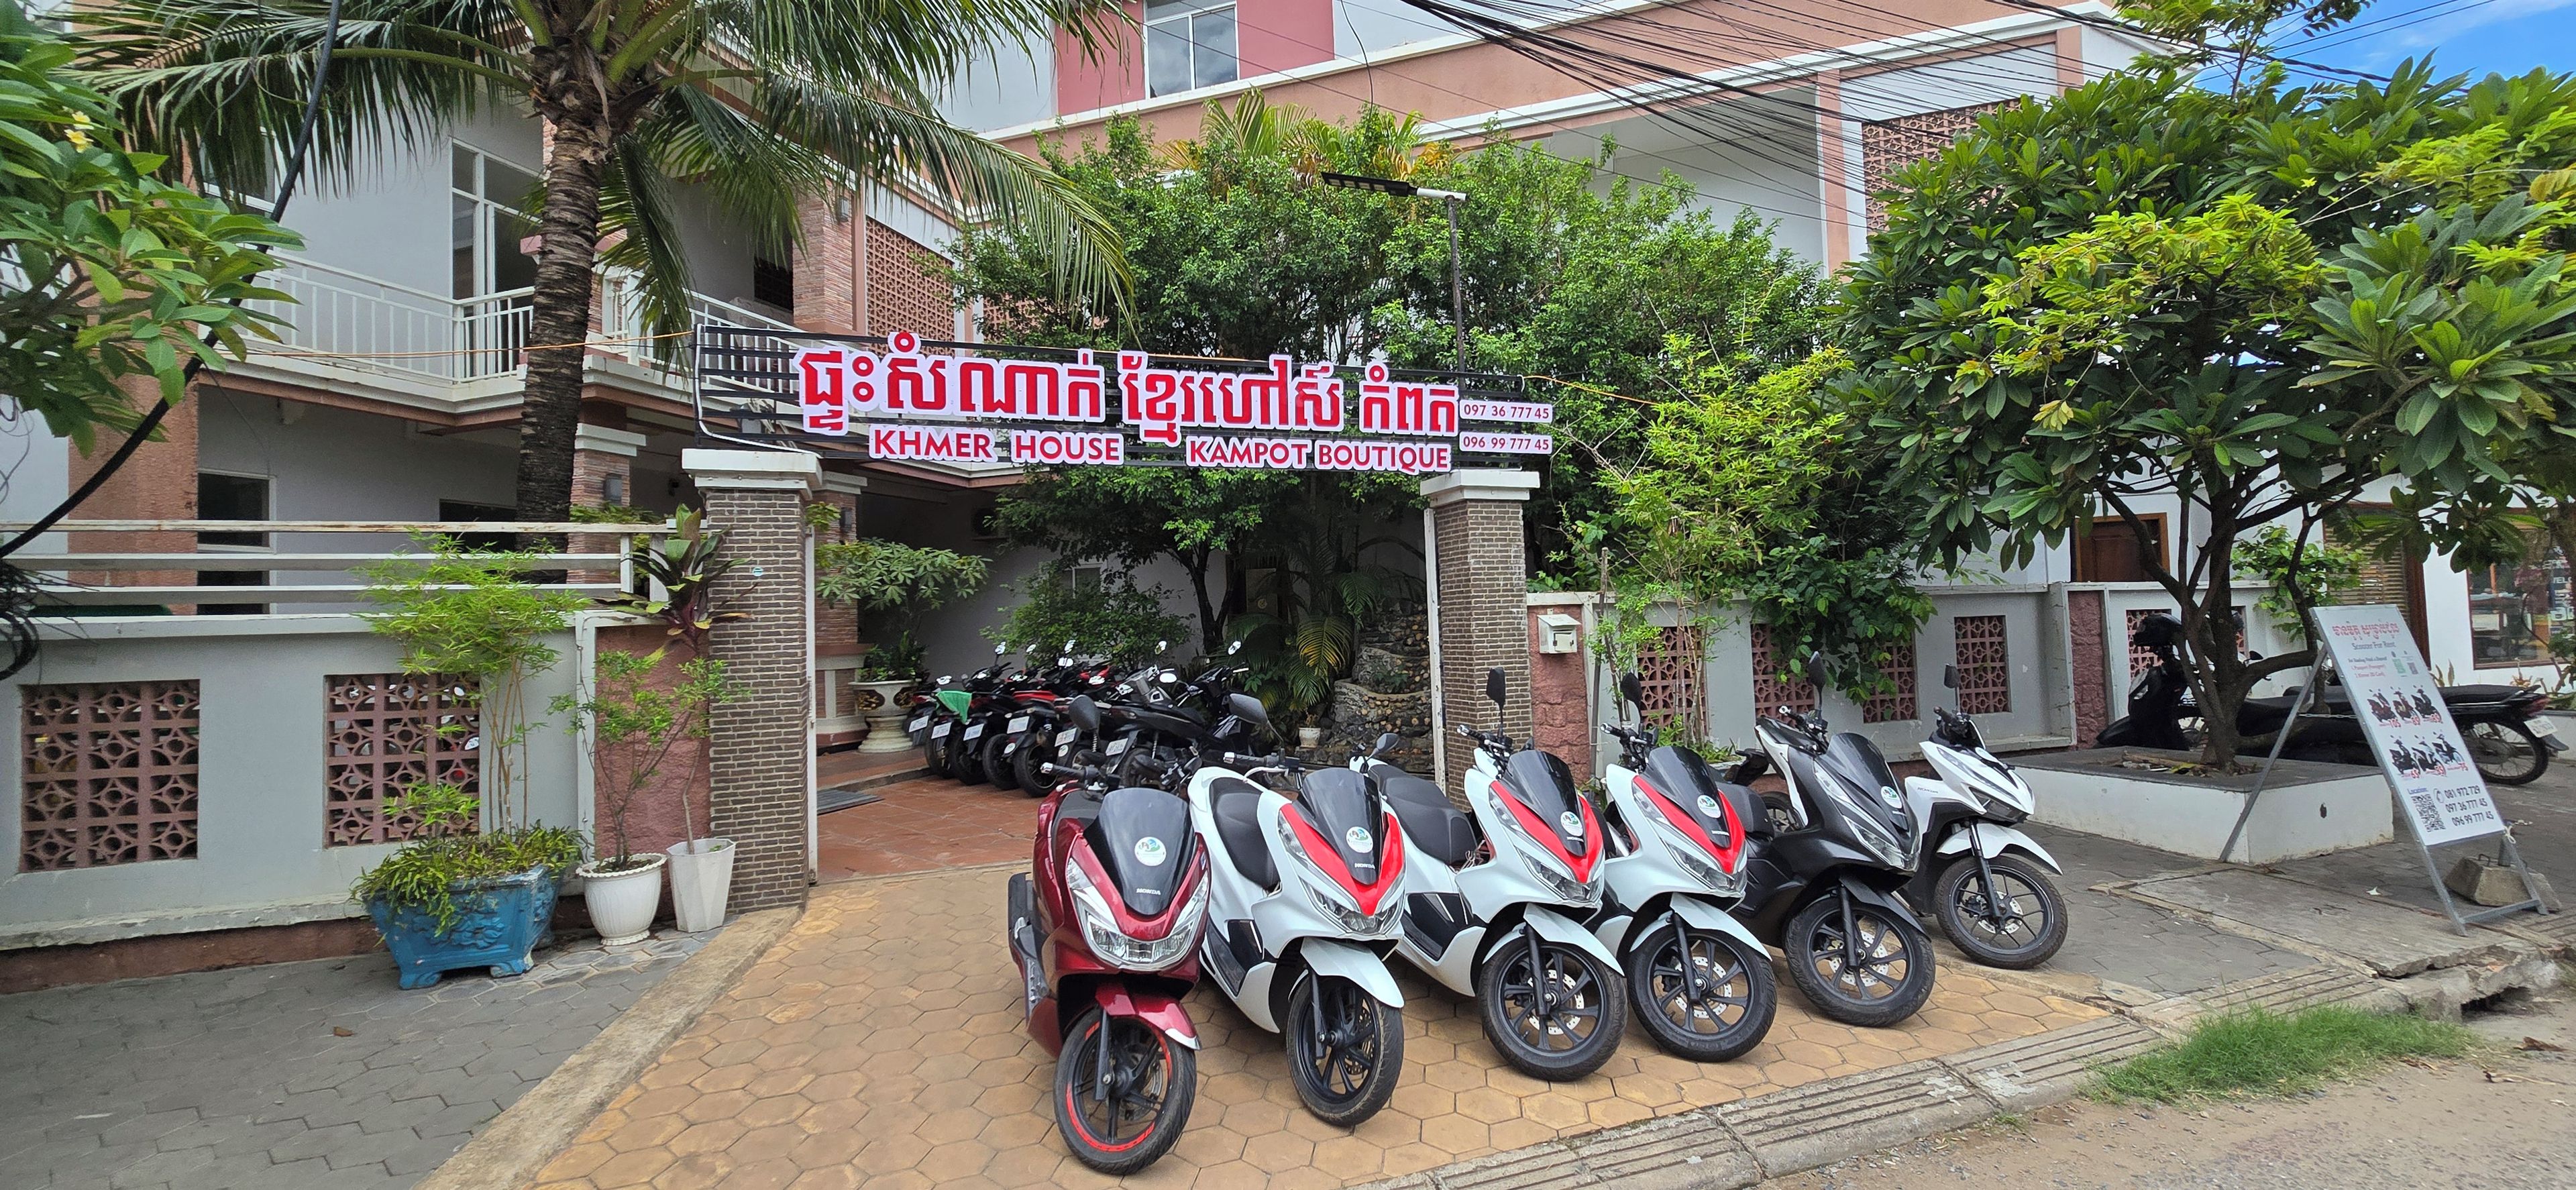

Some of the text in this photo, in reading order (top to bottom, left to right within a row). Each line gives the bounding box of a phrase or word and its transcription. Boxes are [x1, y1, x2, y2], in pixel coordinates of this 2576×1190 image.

[1362, 364, 1455, 433] កំពត
[1464, 404, 1549, 419] 097 36 777 45
[874, 429, 1120, 461] KHMER HOUSE
[1463, 436, 1549, 450] 096 99 777 45
[1189, 440, 1448, 473] KAMPOT BOUTIQUE
[2444, 785, 2480, 798] 081 972 729
[2445, 798, 2487, 813] 097 36 777 45
[2452, 811, 2494, 826] 096 99 777 45
